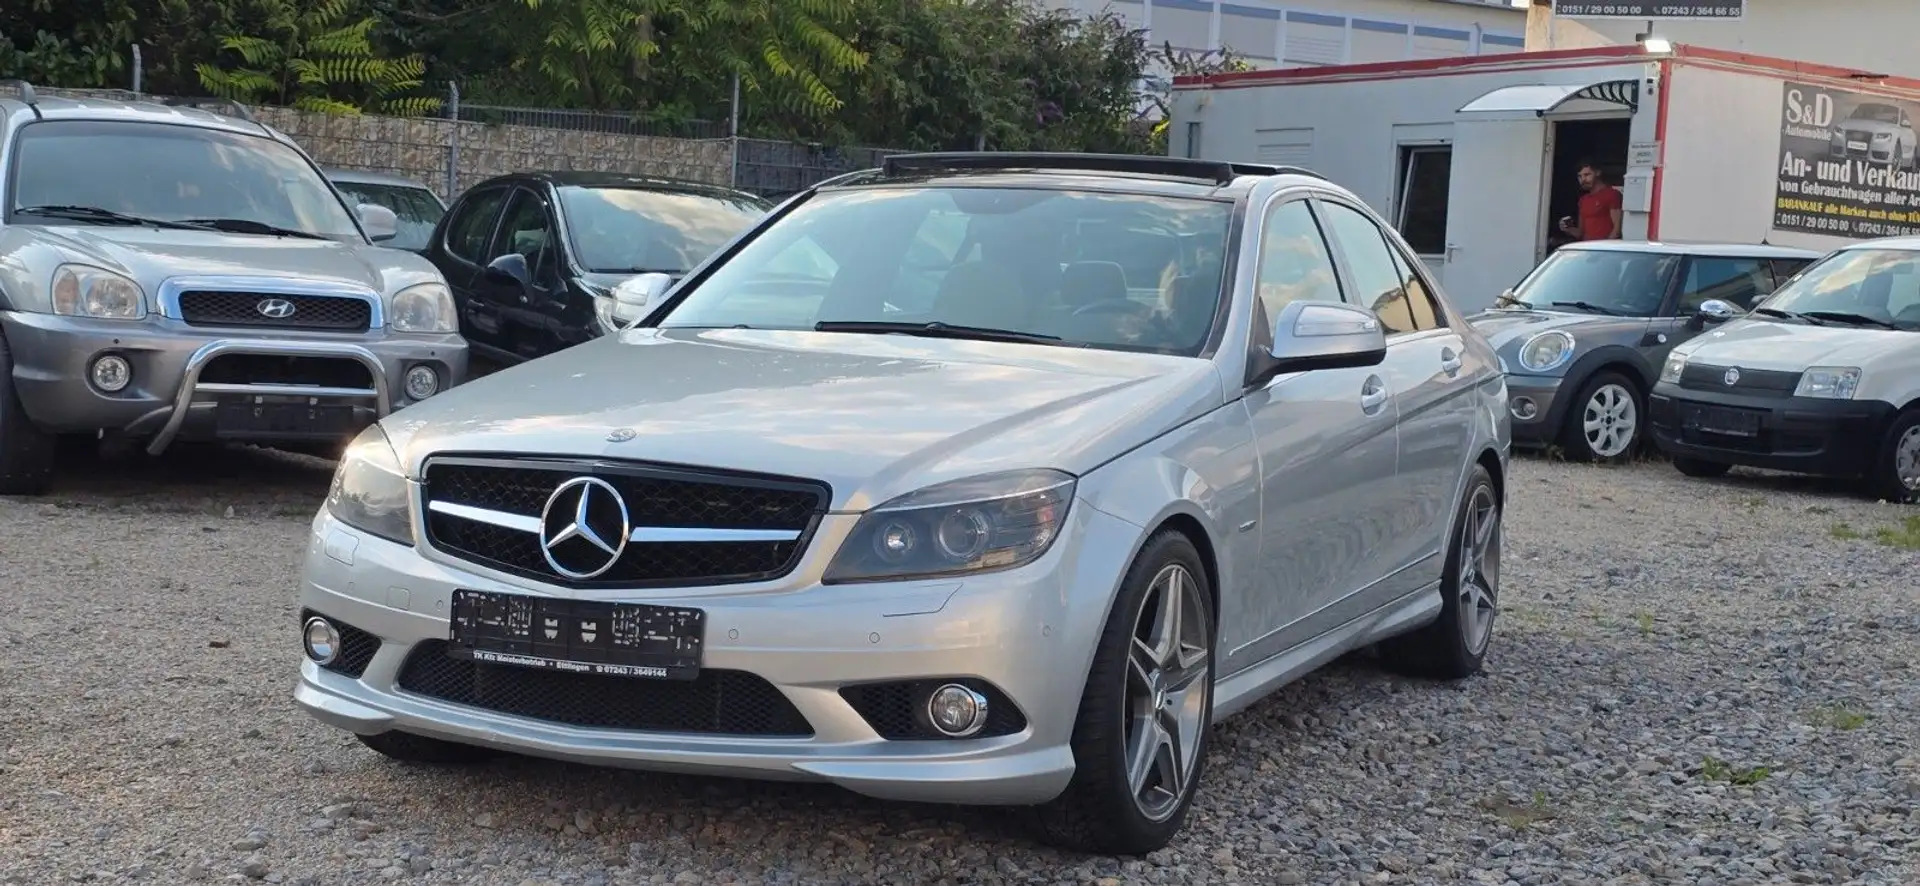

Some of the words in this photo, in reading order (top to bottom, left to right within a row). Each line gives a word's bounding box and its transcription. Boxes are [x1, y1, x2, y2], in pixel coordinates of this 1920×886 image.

[1591, 6, 1602, 14] 29
[1661, 7, 1690, 15] 07243
[1786, 89, 1833, 127] S&D
[1785, 124, 1832, 141] Automobile
[1781, 151, 1812, 177] An-
[1817, 159, 1851, 183] und
[1801, 180, 1882, 204] Gebrauchtwagen
[1884, 191, 1908, 206] aller
[1908, 193, 1920, 207] Ar
[1781, 213, 1800, 226] 0151
[1806, 216, 1817, 228] 29
[1817, 217, 1828, 229] 00
[1828, 218, 1839, 230] 50
[1839, 219, 1849, 231] 00
[497, 654, 546, 667] Meisterbetrieb
[604, 665, 628, 675] 07243
